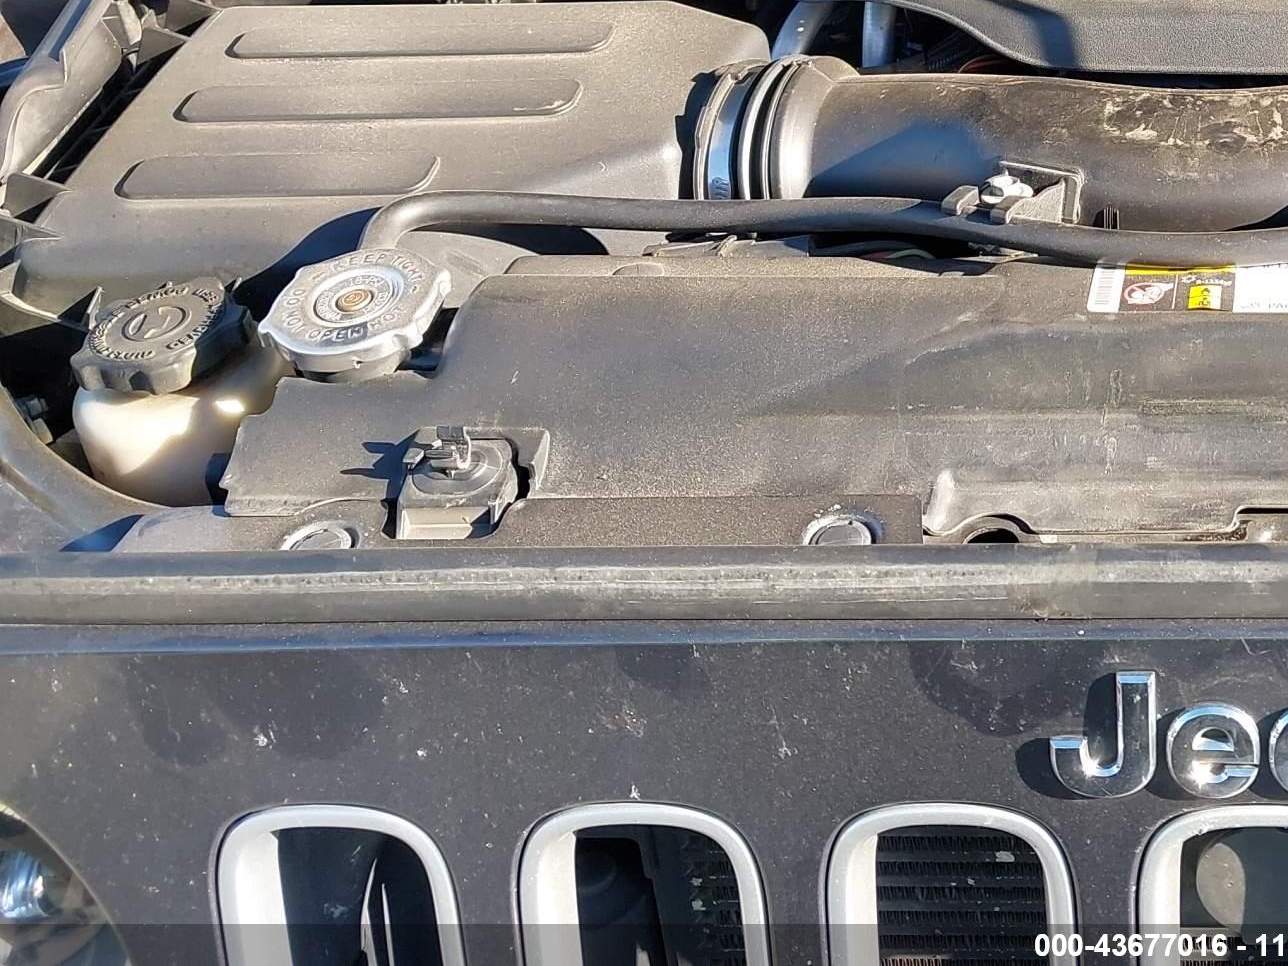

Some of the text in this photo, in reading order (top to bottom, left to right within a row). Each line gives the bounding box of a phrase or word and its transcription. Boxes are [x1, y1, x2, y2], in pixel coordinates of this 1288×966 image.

[331, 252, 426, 284] KEEP TIGHT
[307, 325, 364, 344] OPEN
